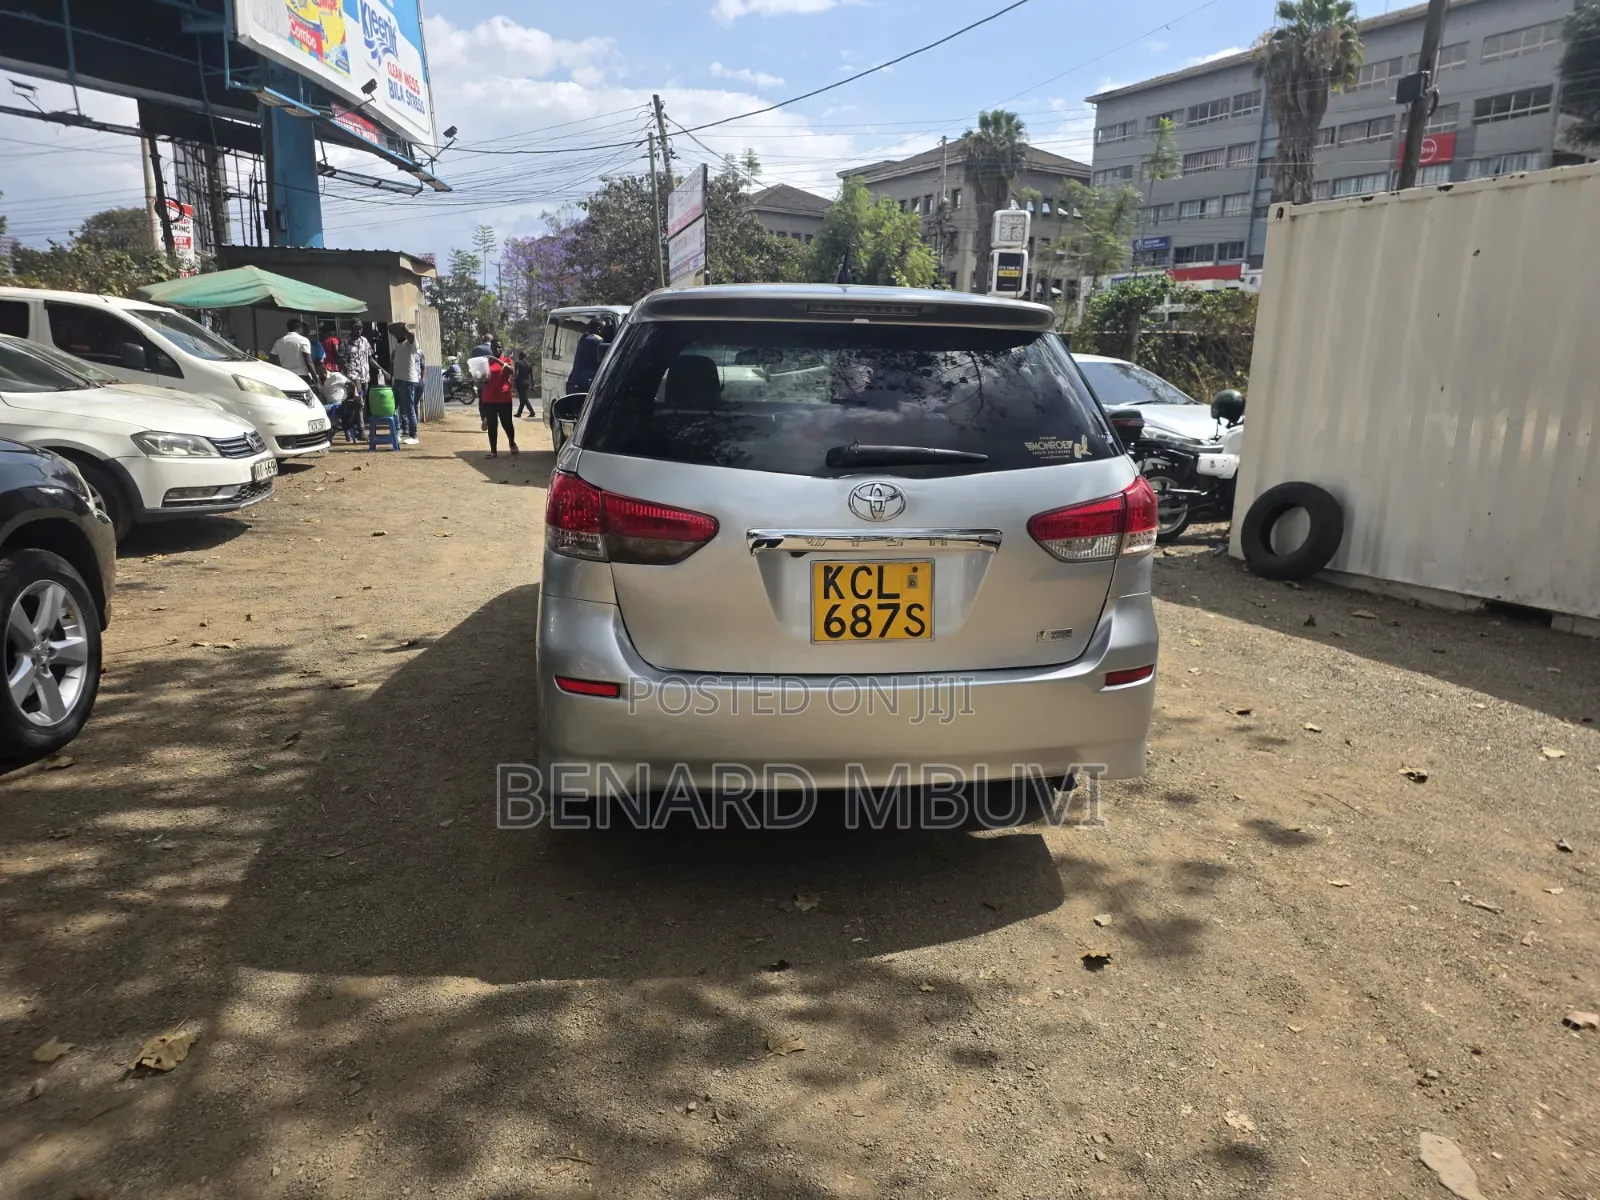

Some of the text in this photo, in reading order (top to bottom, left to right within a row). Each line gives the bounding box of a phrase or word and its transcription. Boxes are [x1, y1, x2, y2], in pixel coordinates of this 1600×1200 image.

[290, 19, 317, 50] Combo
[387, 61, 420, 95] CLEAN MESS
[387, 78, 425, 115] BILA STRESS
[1032, 441, 1070, 450] MONROE
[823, 565, 900, 600] KCL
[823, 603, 926, 638] 687S
